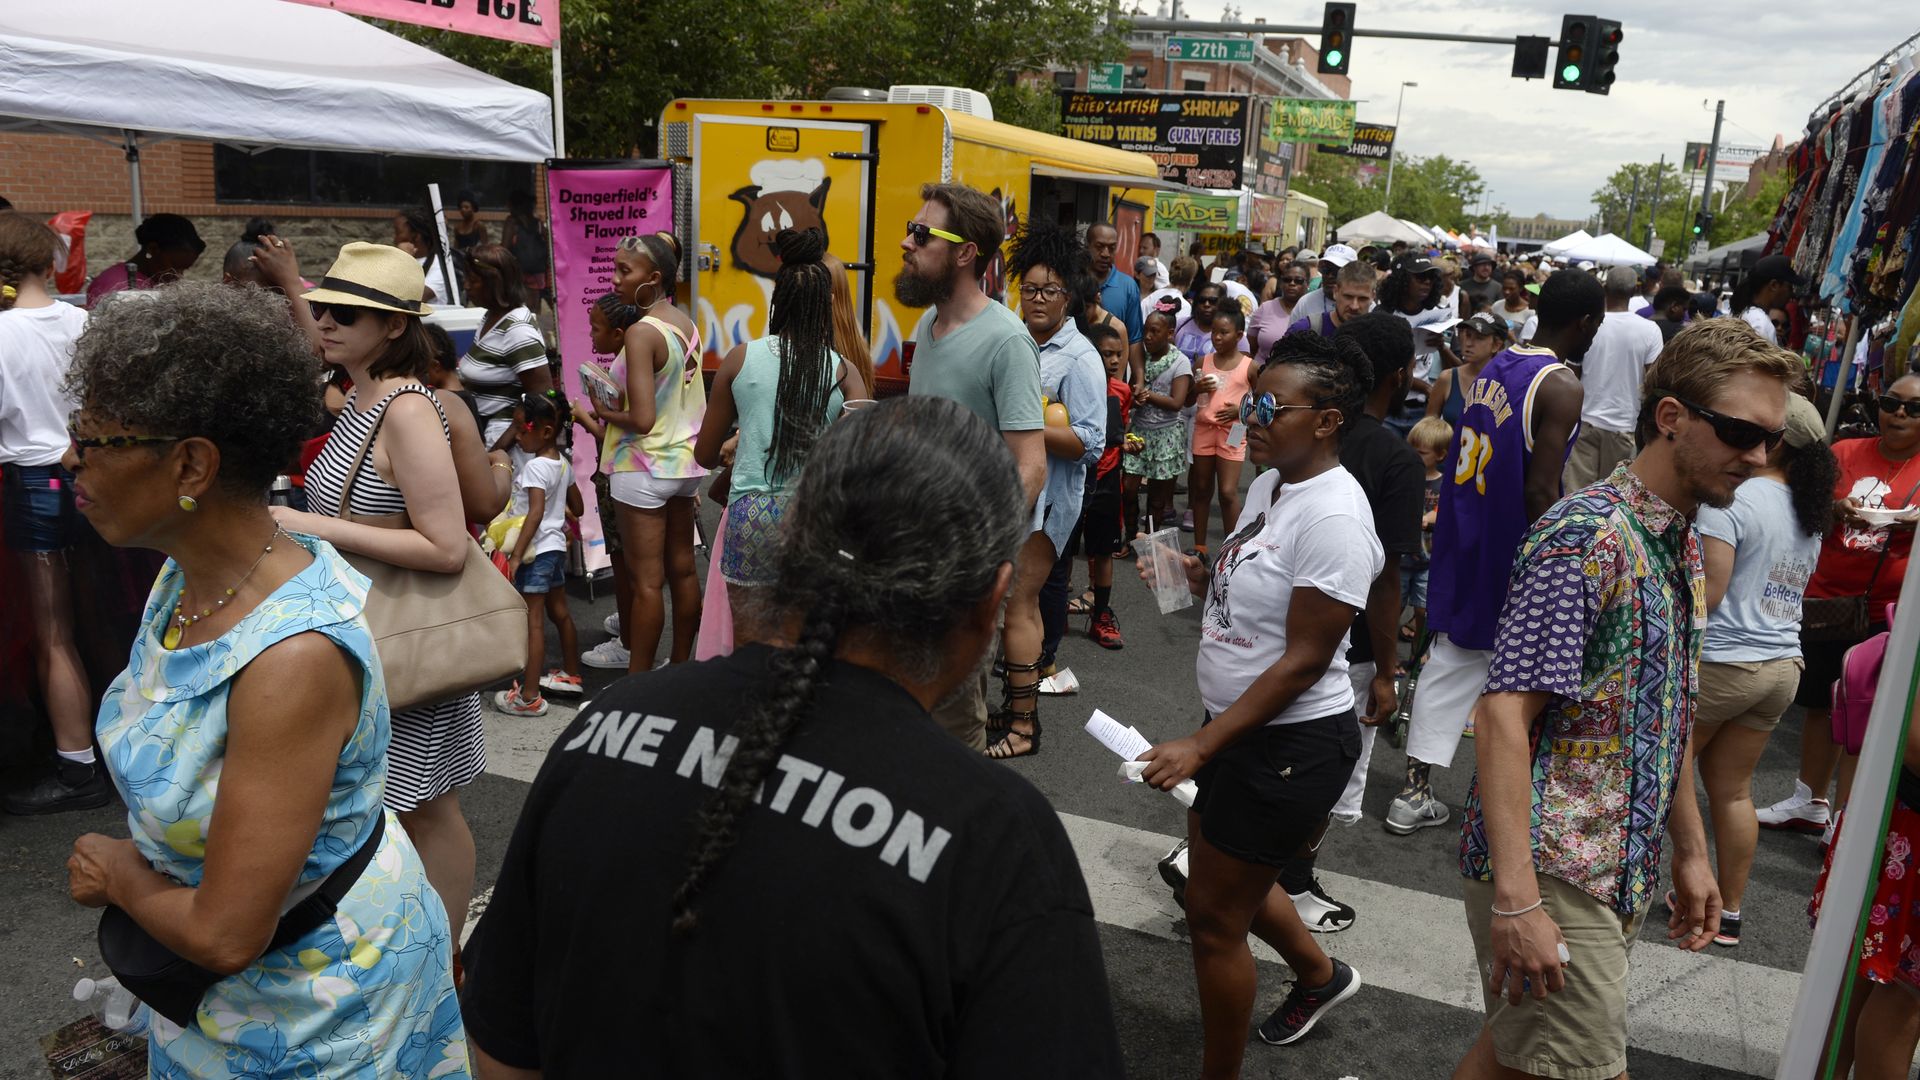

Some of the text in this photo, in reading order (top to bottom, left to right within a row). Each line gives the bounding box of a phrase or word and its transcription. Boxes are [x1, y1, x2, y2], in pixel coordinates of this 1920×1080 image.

[1191, 42, 1228, 58] 27th
[1069, 101, 1105, 113] FRIED
[1107, 98, 1159, 114] CATFISH
[1181, 100, 1240, 117] SHRIMP
[1273, 111, 1352, 131] LEMONADE
[1066, 124, 1114, 140] TWISTED
[1116, 125, 1157, 142] TATERS
[1168, 126, 1207, 145] CURLY
[1206, 127, 1241, 146] FRIES
[1346, 143, 1388, 157] SHRIMP
[1170, 153, 1199, 167] FRIES
[559, 187, 658, 206] Dangerfield's
[570, 206, 648, 222] Shaved Ice
[1155, 199, 1230, 222] NADE
[584, 224, 638, 239] Flavors
[595, 246, 618, 254] Banan
[591, 256, 615, 264] Bluebe
[583, 287, 613, 295] Coconut
[1463, 378, 1514, 428] JOHNSON
[1763, 582, 1803, 606] BeHear
[1760, 598, 1802, 621] MILE HIG
[676, 725, 953, 884] NTION
